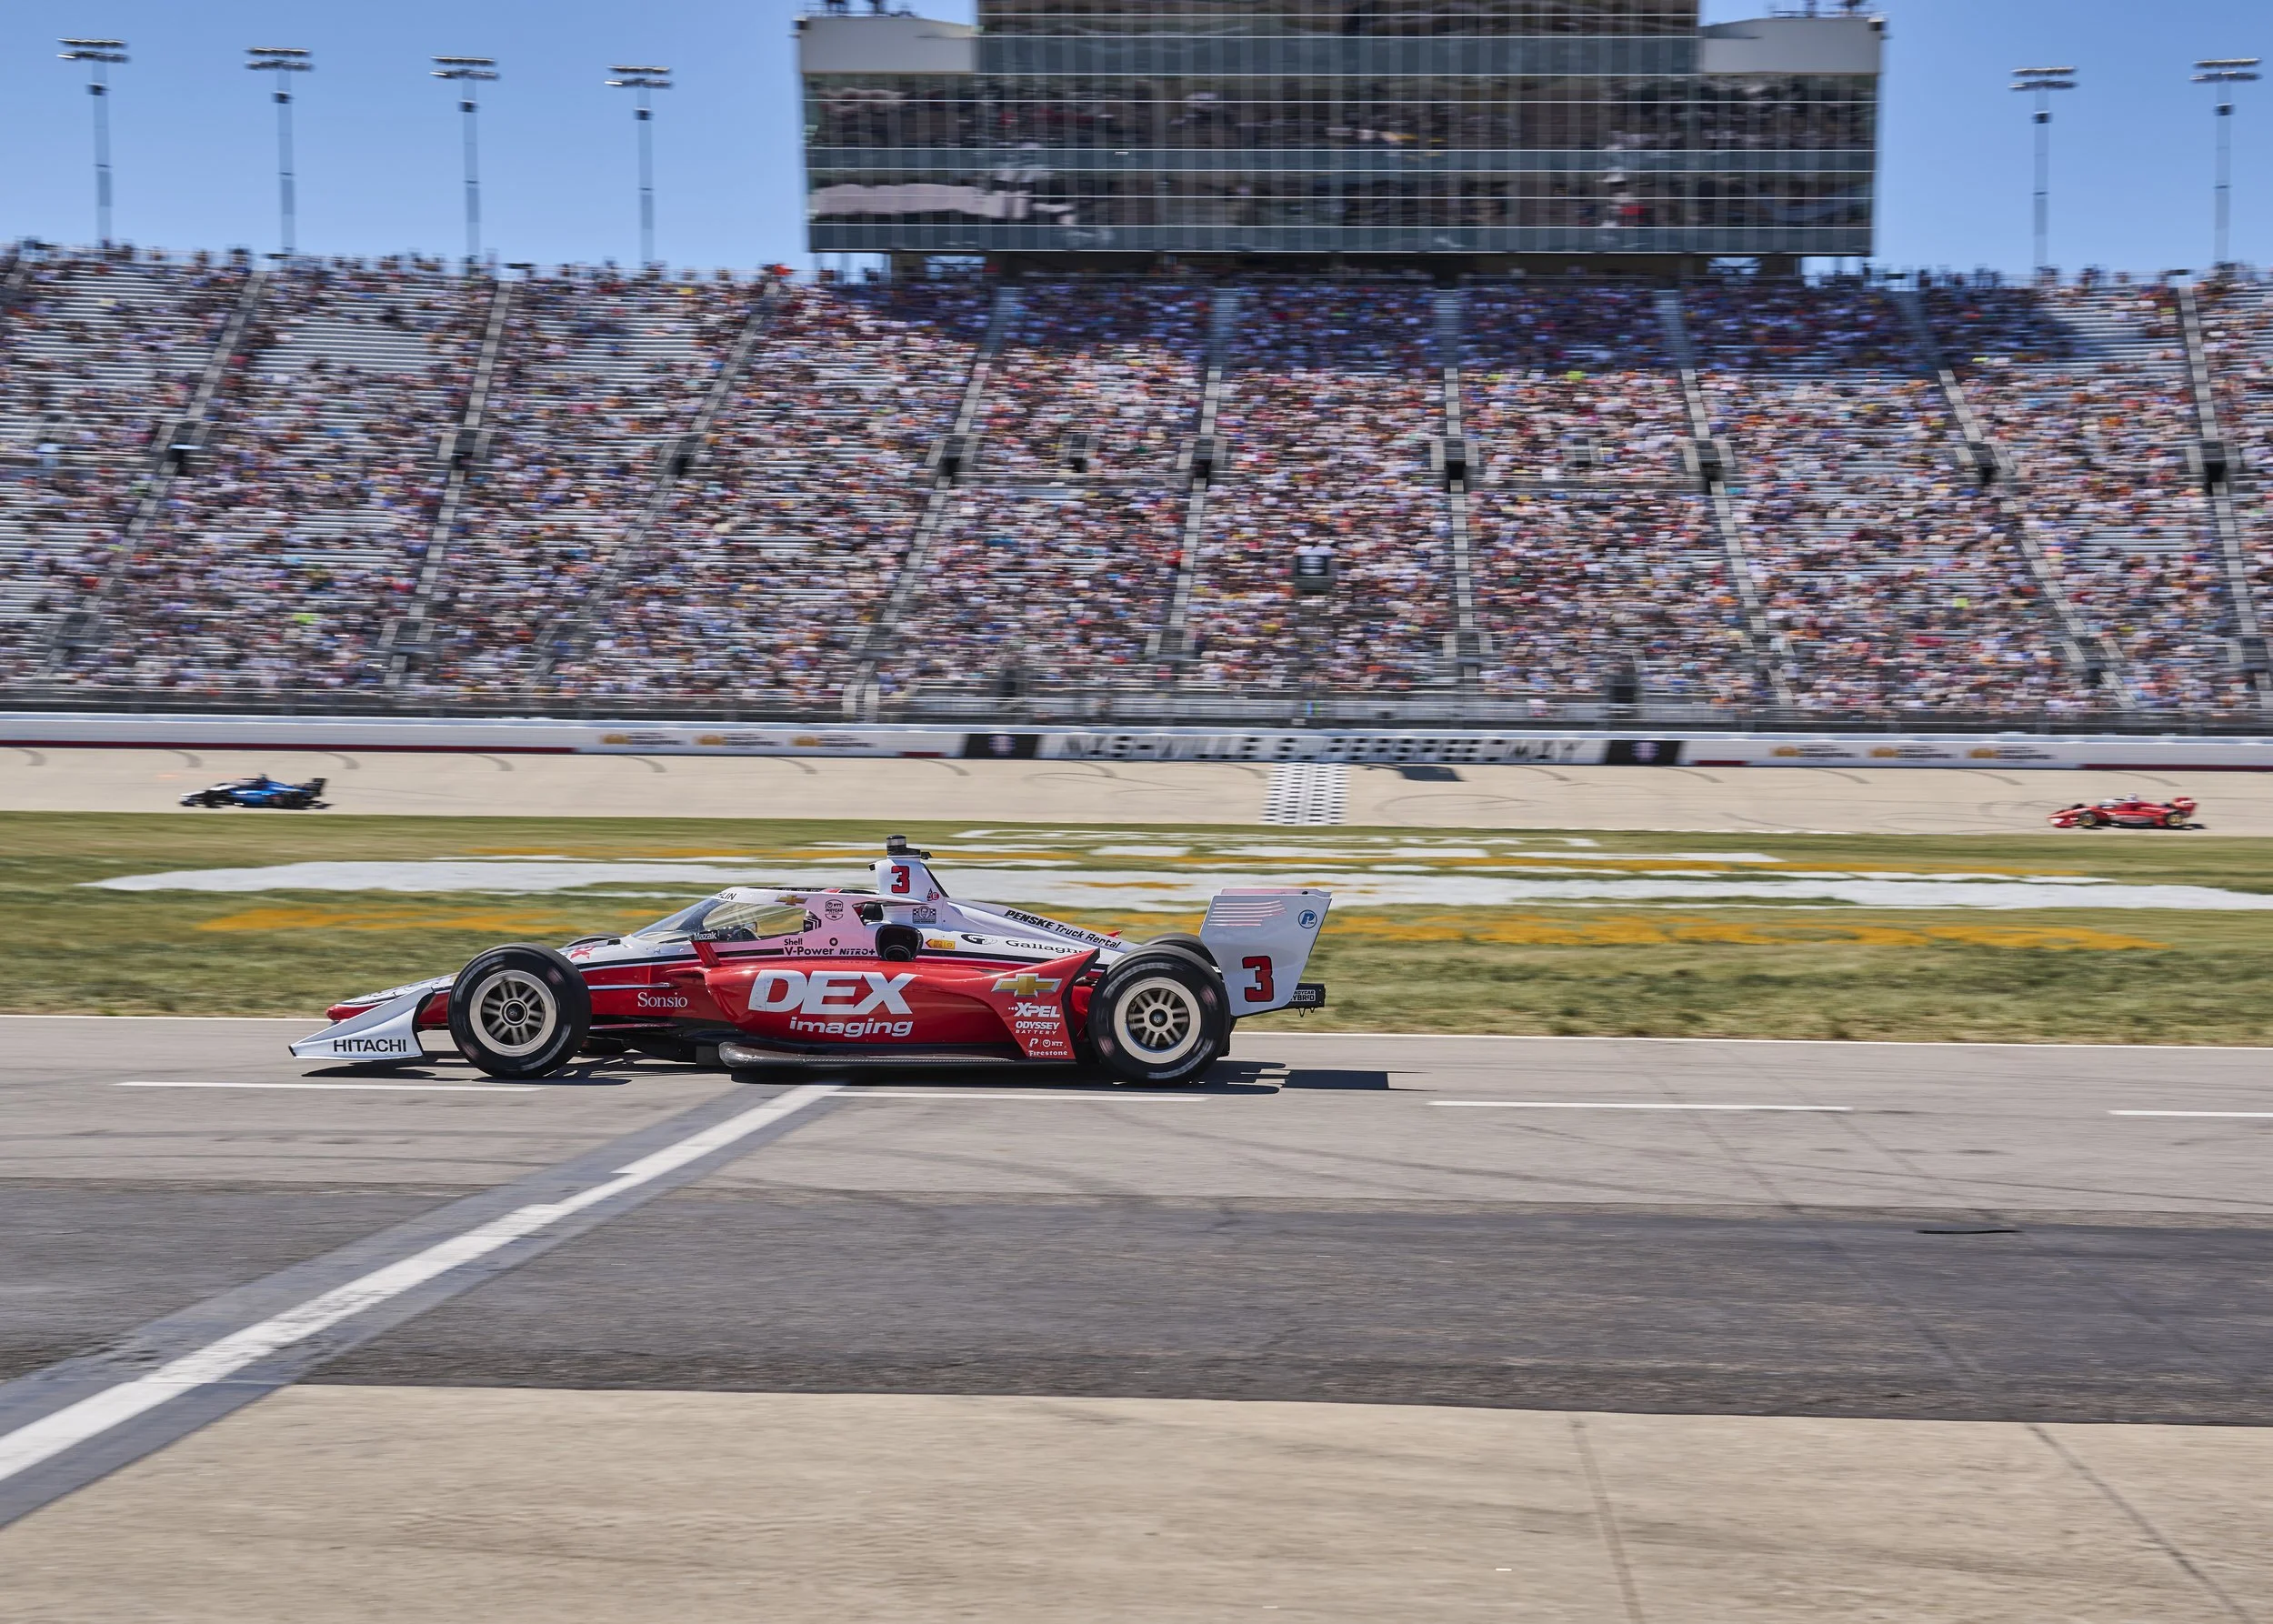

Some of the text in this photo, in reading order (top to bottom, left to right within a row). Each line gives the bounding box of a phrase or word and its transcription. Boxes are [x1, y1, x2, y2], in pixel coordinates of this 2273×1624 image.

[891, 866, 910, 893] 3
[694, 929, 717, 941] Mazak
[1004, 909, 1122, 949] PENSKE Truck Rental
[784, 937, 803, 946] Shell
[784, 947, 835, 956] V-Power
[1242, 956, 1274, 1002] 3
[637, 992, 688, 1007] Sonsio
[748, 969, 923, 1015] DEX
[1014, 1002, 1061, 1018] XPEL
[789, 1017, 914, 1038] imaging
[1015, 1020, 1061, 1030] ODYSSEY
[333, 1038, 407, 1052] HITACHI
